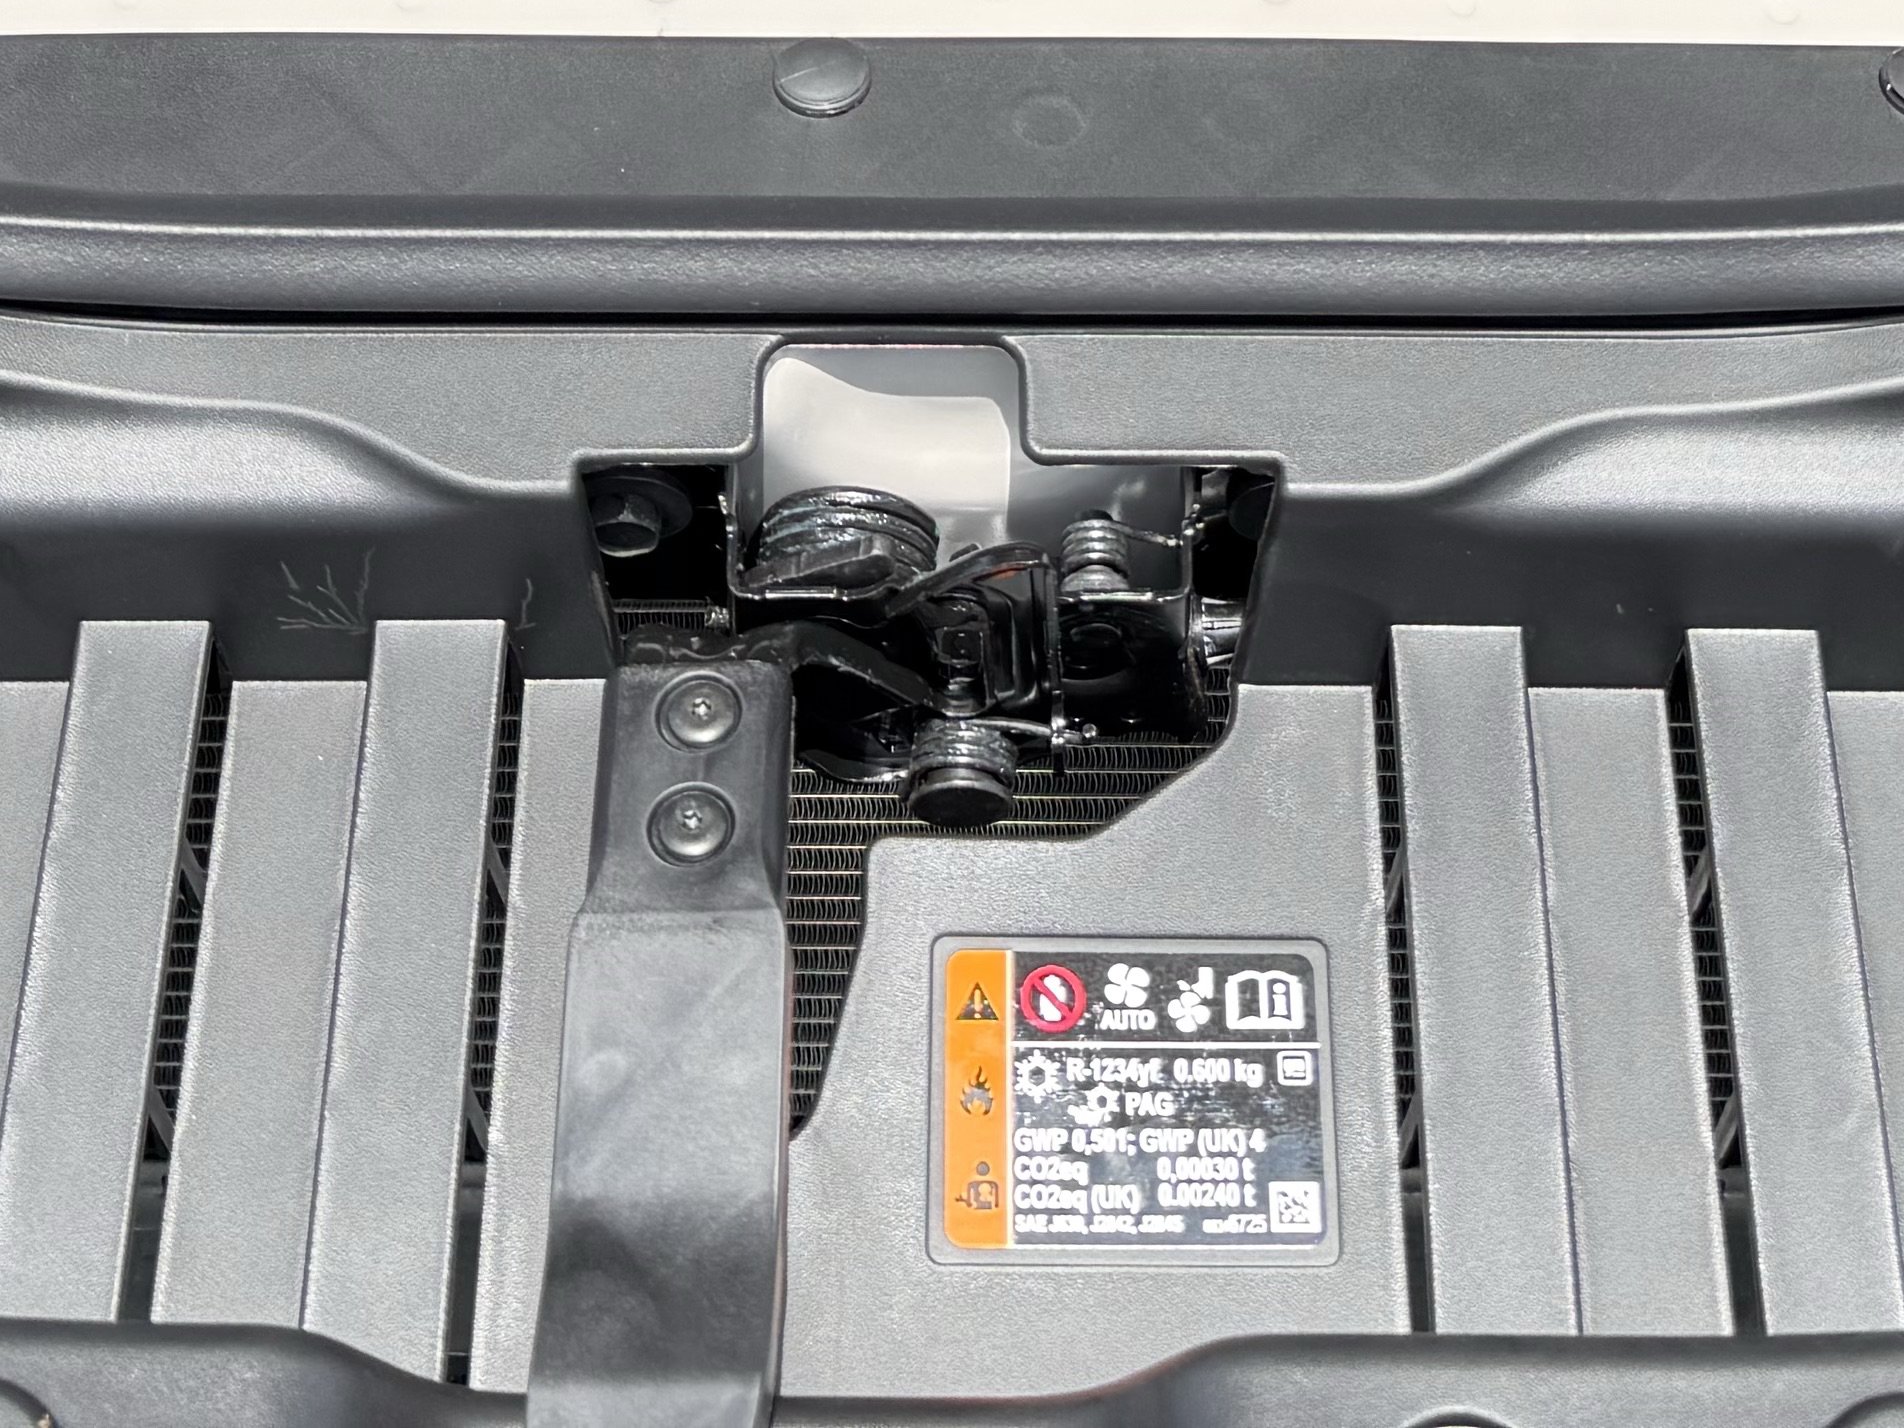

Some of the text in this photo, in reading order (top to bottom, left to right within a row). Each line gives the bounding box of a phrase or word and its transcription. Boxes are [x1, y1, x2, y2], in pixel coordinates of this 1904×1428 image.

[1099, 1009, 1157, 1030] AUTO
[1065, 1057, 1264, 1088] R-1234yf 0.600 kg
[1125, 1092, 1175, 1116] PAG
[1014, 1128, 1068, 1152] GWP
[1139, 1128, 1195, 1152] GWP
[1197, 1128, 1246, 1157] (UK)
[1248, 1128, 1267, 1152] 4
[1014, 1156, 1089, 1185] CO2eq
[1243, 1157, 1255, 1180] t
[1014, 1184, 1089, 1214] CO2eq
[1091, 1184, 1141, 1214] (UK)
[1244, 1184, 1256, 1207] t
